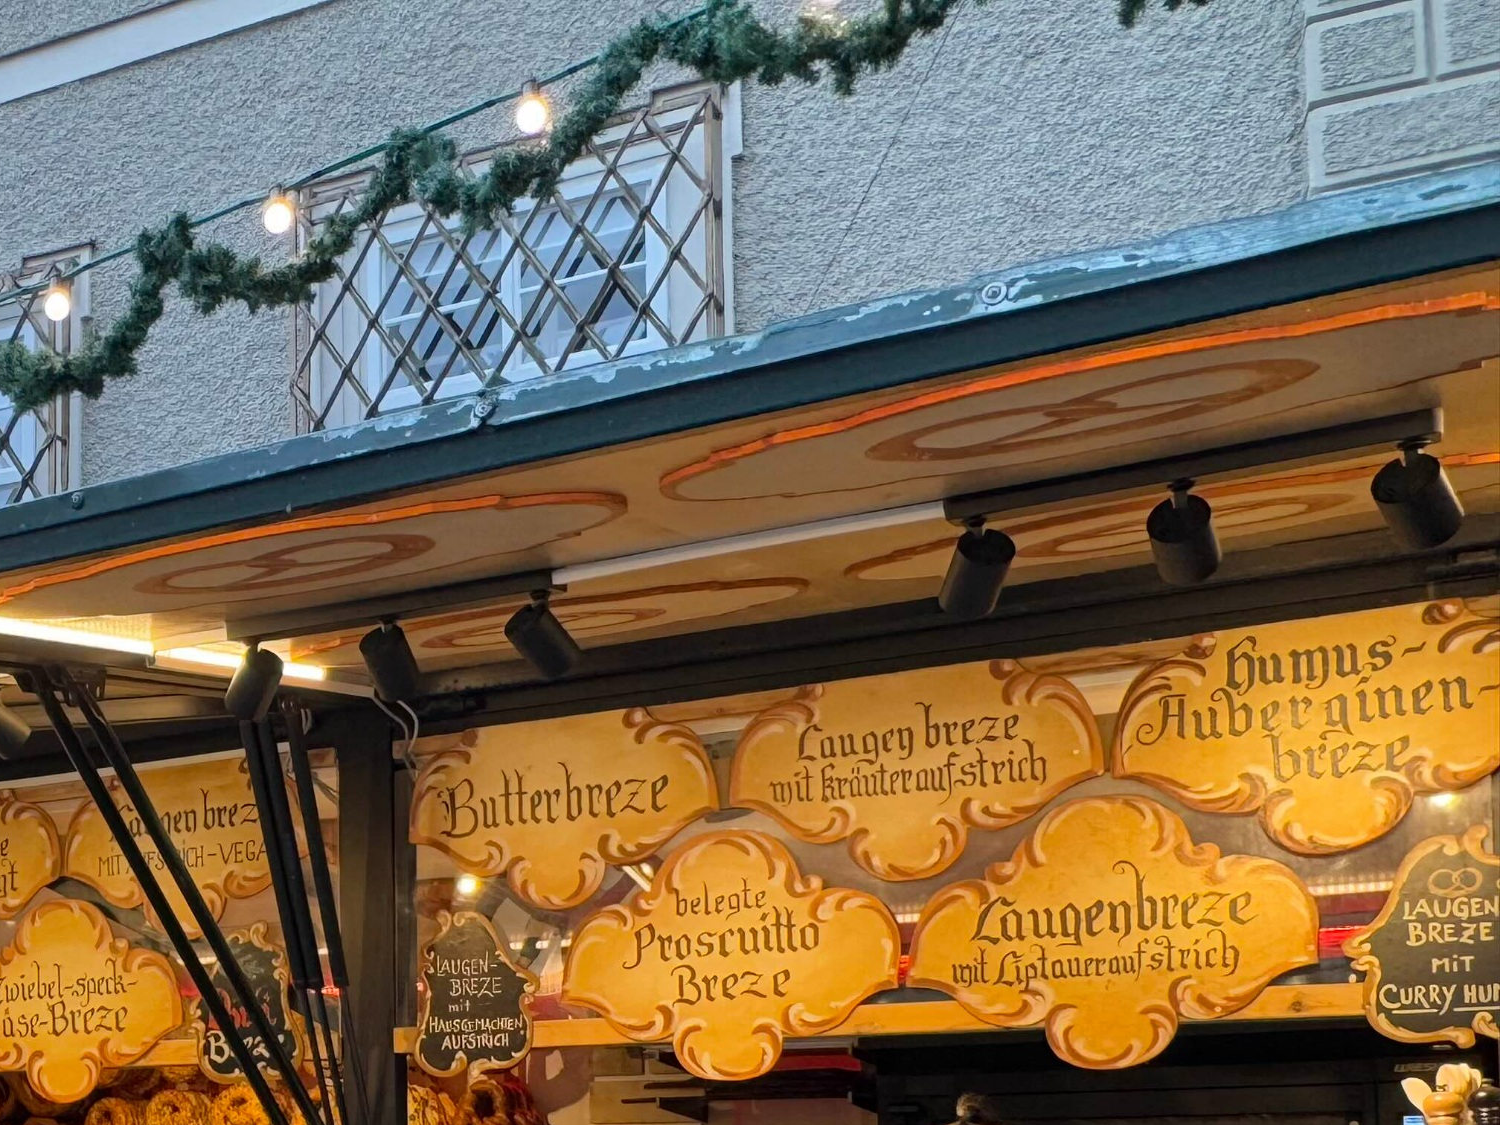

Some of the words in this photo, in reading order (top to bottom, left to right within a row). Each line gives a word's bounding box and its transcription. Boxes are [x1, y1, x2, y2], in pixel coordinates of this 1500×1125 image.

[1225, 634, 1426, 695] Humus-
[1270, 734, 1411, 784] breze
[439, 762, 669, 837] Butterbreze
[769, 768, 813, 804] mit
[674, 879, 768, 917] belegte
[969, 860, 1259, 947] Laugenbreze
[1406, 922, 1494, 946] BREZE
[436, 951, 497, 976] LAUGEN-
[951, 946, 988, 986] mit
[992, 928, 1240, 990] Liptaueraufstrich
[449, 999, 470, 1012] mit
[450, 977, 501, 997] BREZE
[670, 967, 792, 1007] Breze
[1380, 984, 1457, 1015] CURRY
[441, 1032, 509, 1050] AUFSTRICH
